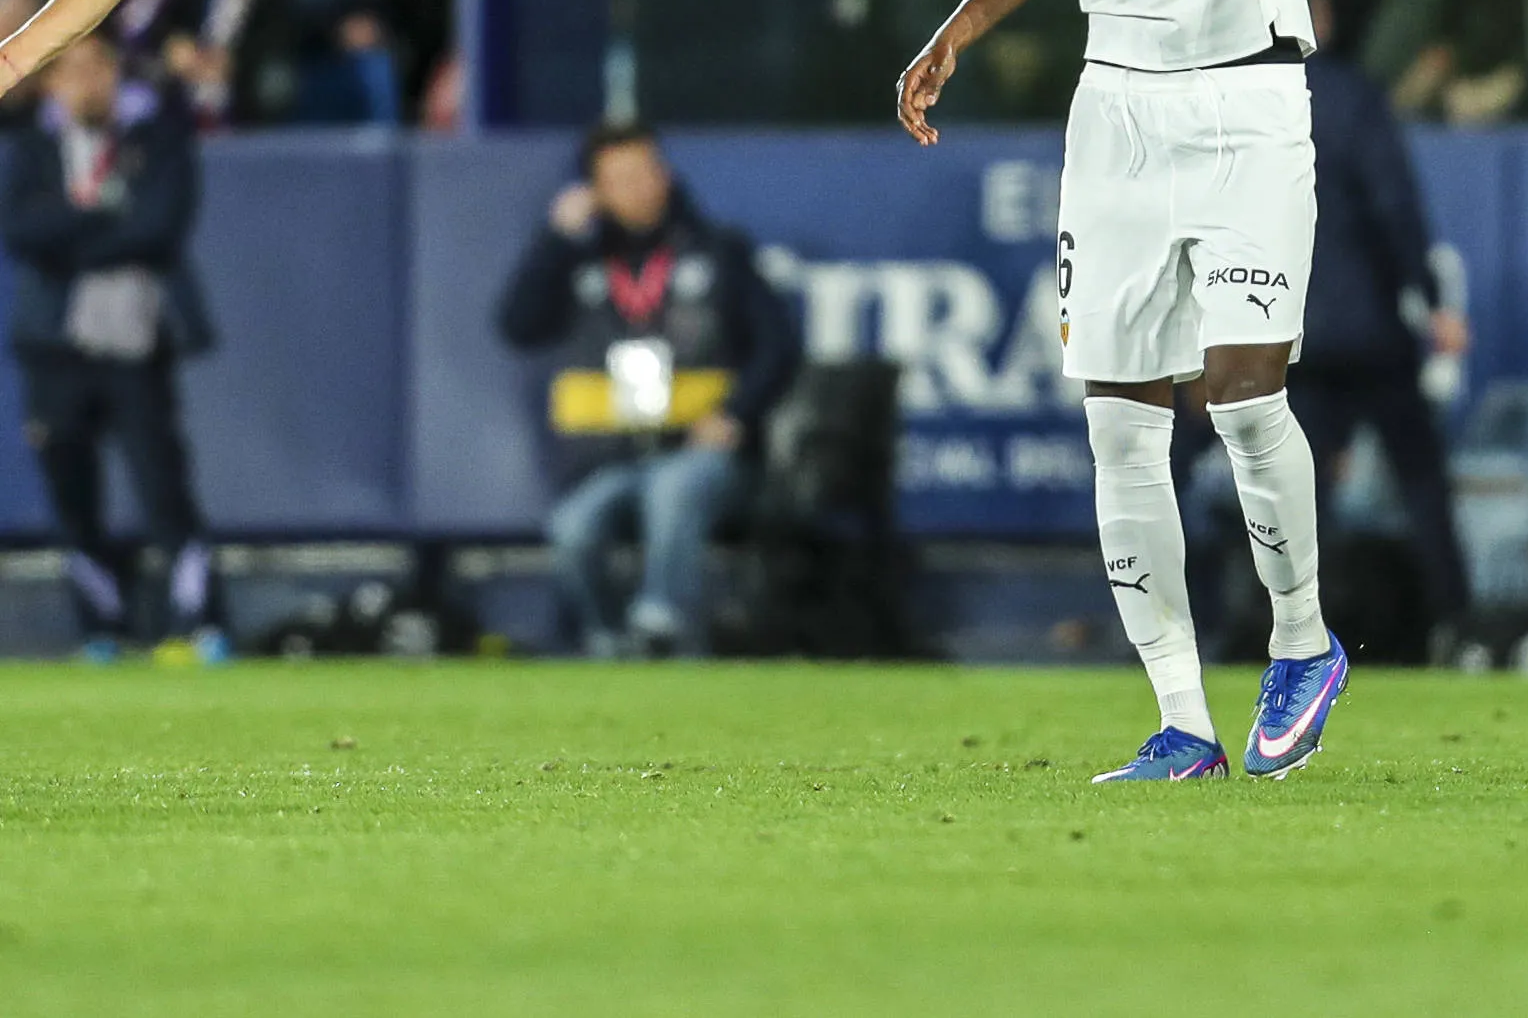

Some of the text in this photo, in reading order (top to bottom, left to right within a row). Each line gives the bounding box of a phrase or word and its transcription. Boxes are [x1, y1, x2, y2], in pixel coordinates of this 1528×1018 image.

[1058, 230, 1075, 299] 6
[1206, 266, 1290, 291] SKODA
[1248, 518, 1279, 536] VCF
[1107, 556, 1138, 572] VCF
